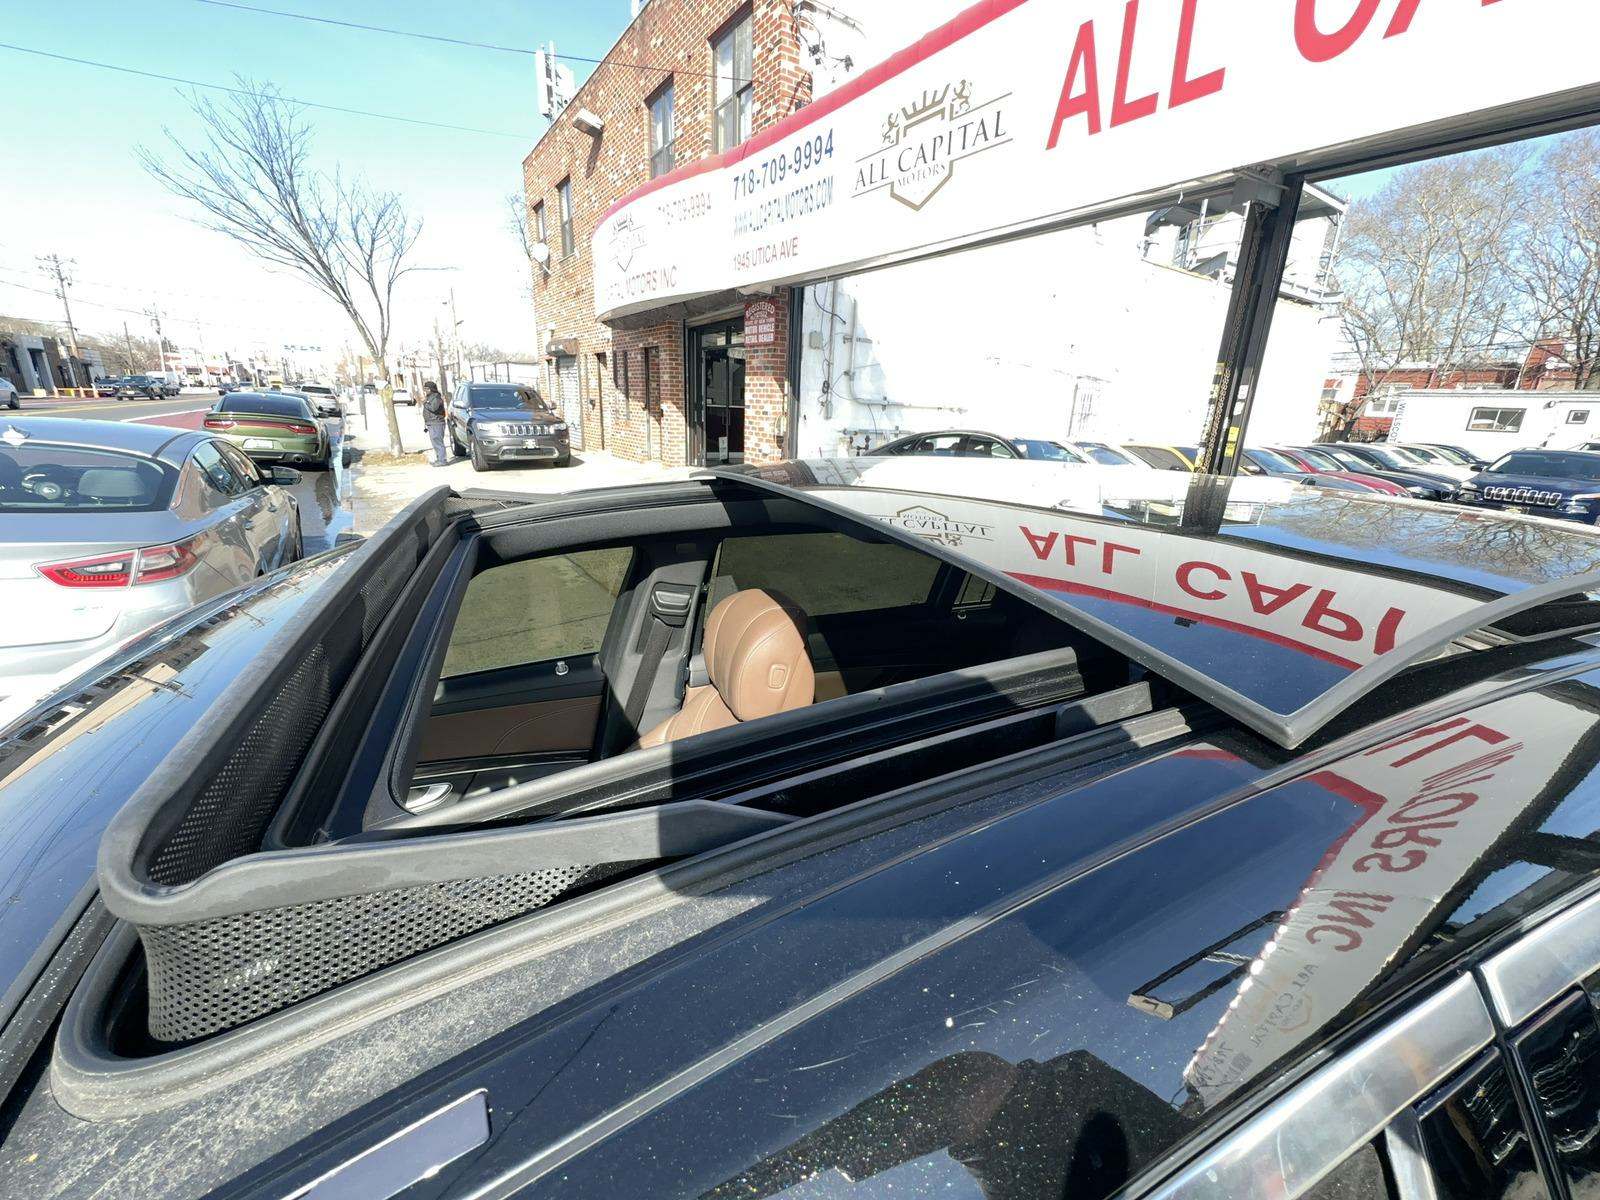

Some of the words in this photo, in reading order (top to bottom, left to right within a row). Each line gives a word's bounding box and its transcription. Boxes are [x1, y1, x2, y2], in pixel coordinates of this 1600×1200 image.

[1046, 0, 1226, 151] ALL
[734, 128, 834, 200] 718-709-9994
[855, 158, 889, 191] ALL
[898, 110, 1006, 173] CAPITAL
[898, 163, 946, 187] MOTORS
[660, 264, 678, 288] INC
[733, 251, 750, 271] 1945
[752, 244, 778, 267] UTICA
[780, 236, 799, 260] AVE
